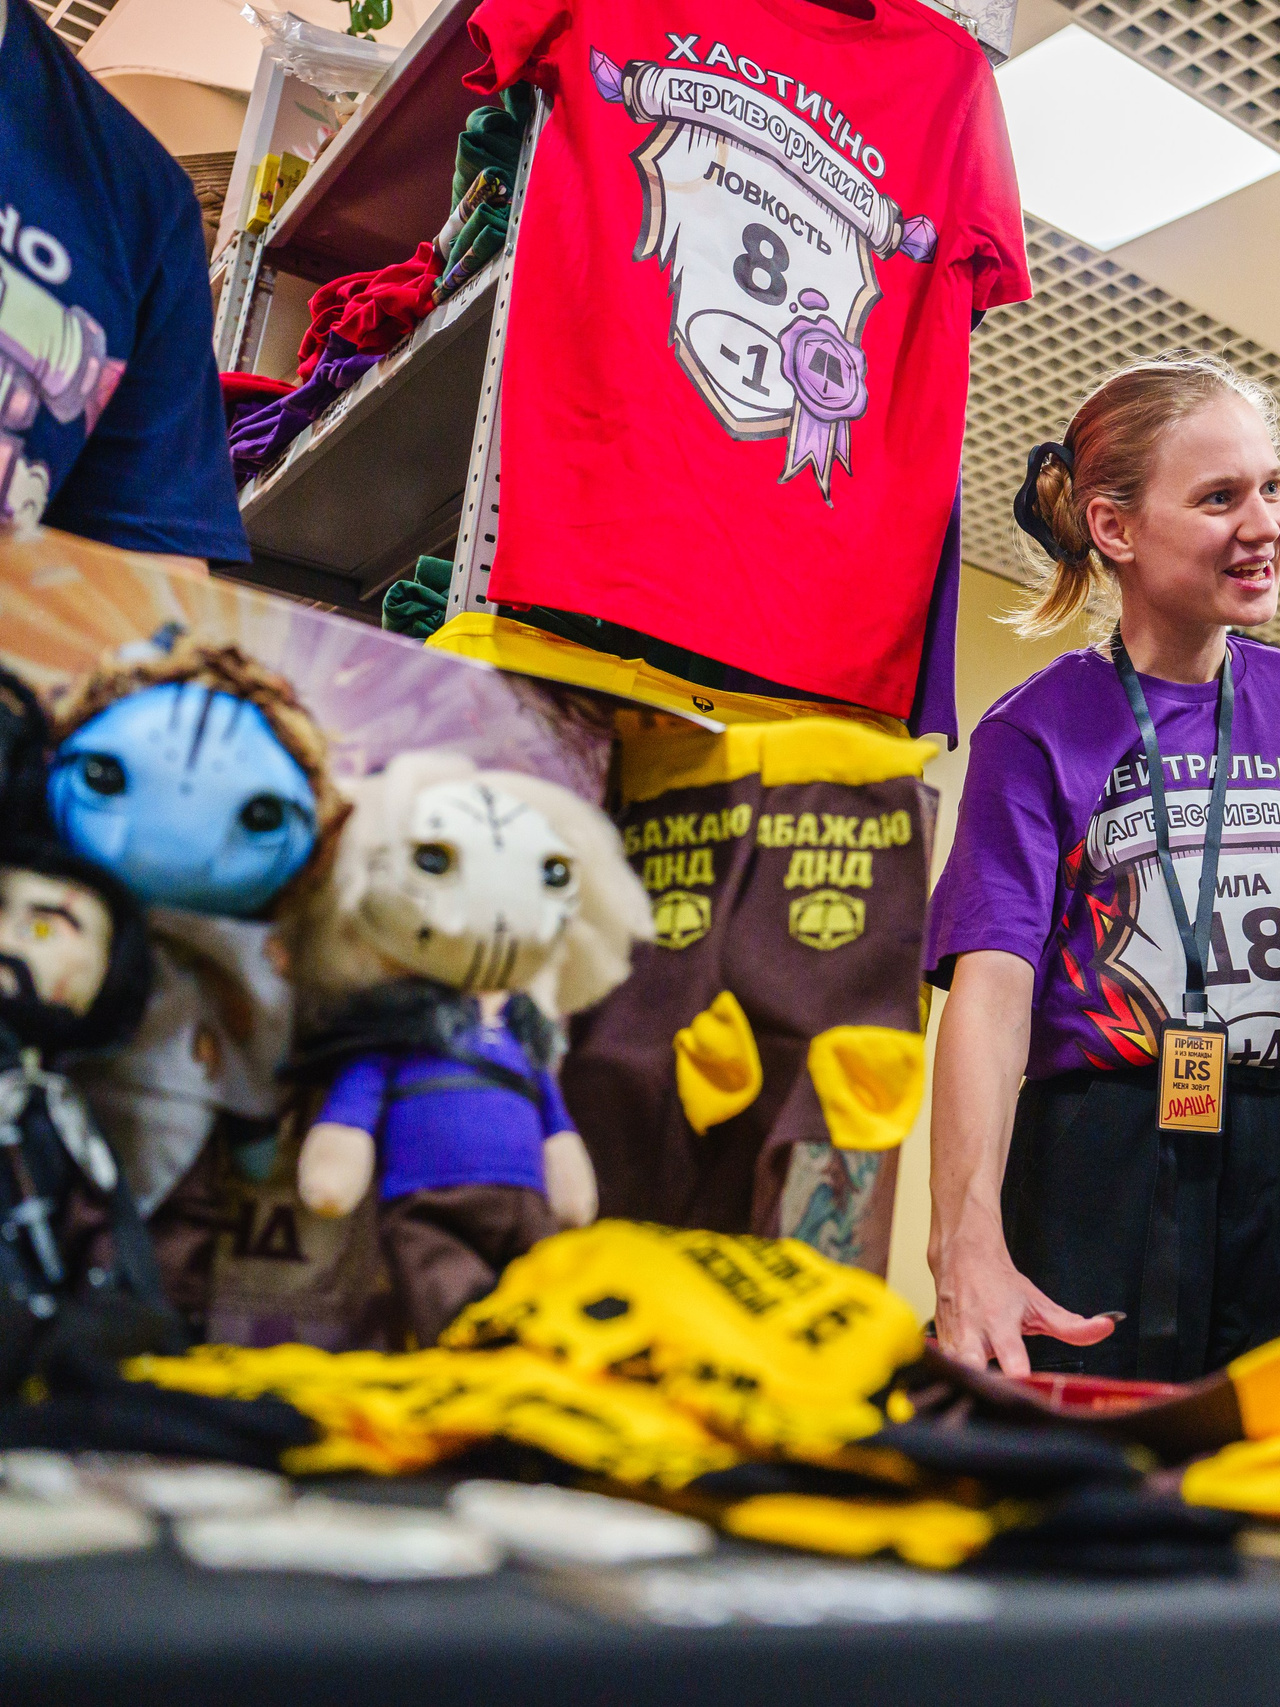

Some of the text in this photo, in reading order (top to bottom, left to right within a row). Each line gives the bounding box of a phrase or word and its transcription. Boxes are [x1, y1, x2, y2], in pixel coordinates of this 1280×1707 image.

[665, 32, 886, 178] ХАОТИЧНО
[669, 78, 875, 217] криворукий
[703, 161, 832, 255] ЛОВКОСТЬ
[733, 223, 790, 306] 8
[720, 343, 770, 397] -1
[783, 850, 873, 890] ДНД
[1198, 873, 1271, 898] ИЛА
[1174, 1038, 1213, 1051] ПРИВЕТ!
[1172, 1082, 1210, 1092] МЕНЯ ЗОВУТ
[1174, 1058, 1211, 1081] LRS
[1164, 1093, 1216, 1121] МАША
